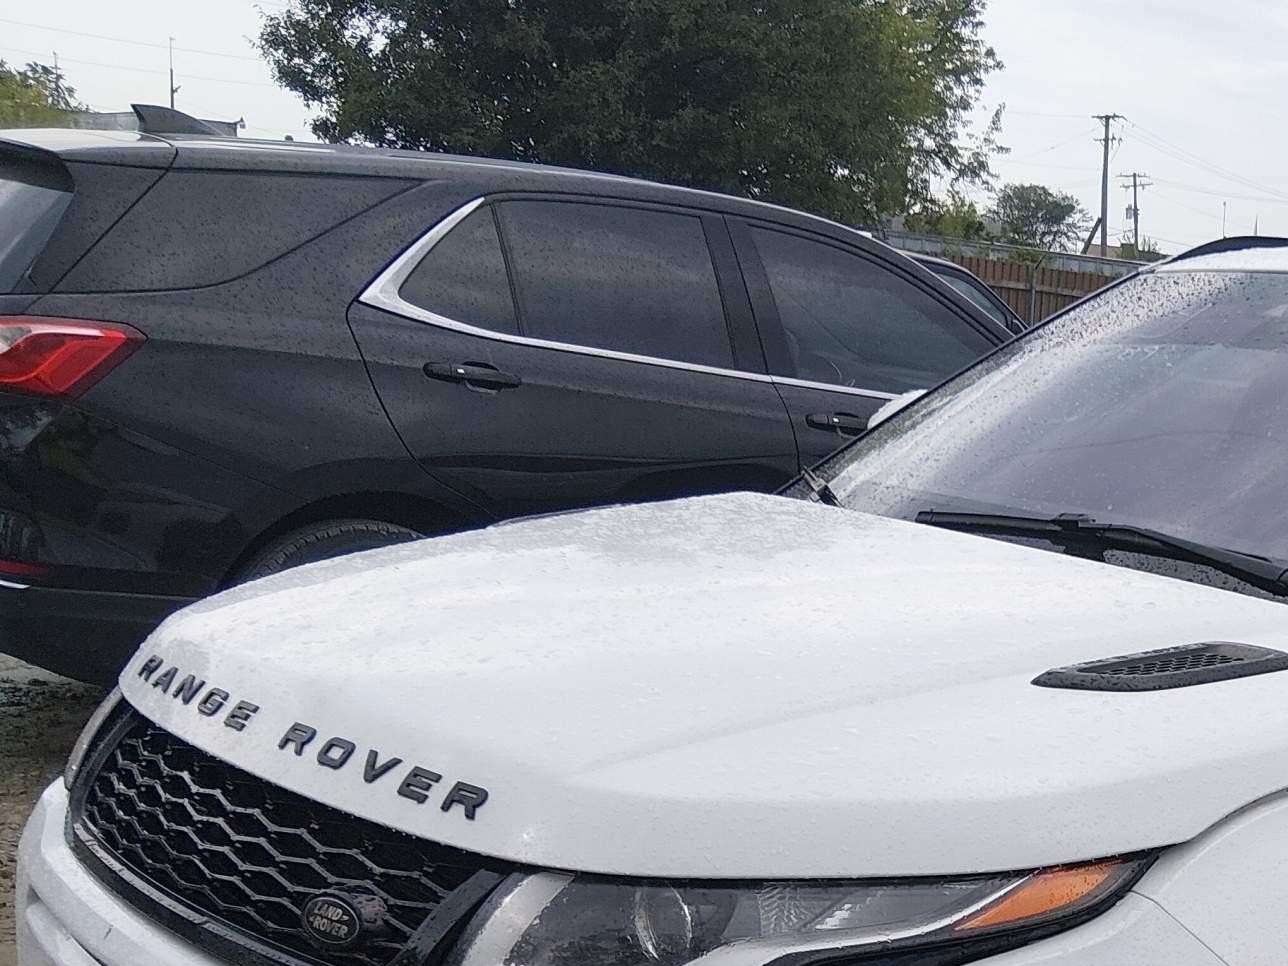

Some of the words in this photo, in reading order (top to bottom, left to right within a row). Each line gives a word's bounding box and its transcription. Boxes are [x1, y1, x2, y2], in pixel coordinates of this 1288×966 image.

[138, 654, 260, 732] RANGE
[278, 721, 488, 820] ROVER
[314, 902, 343, 920] LAND
[314, 917, 348, 938] ROVER
